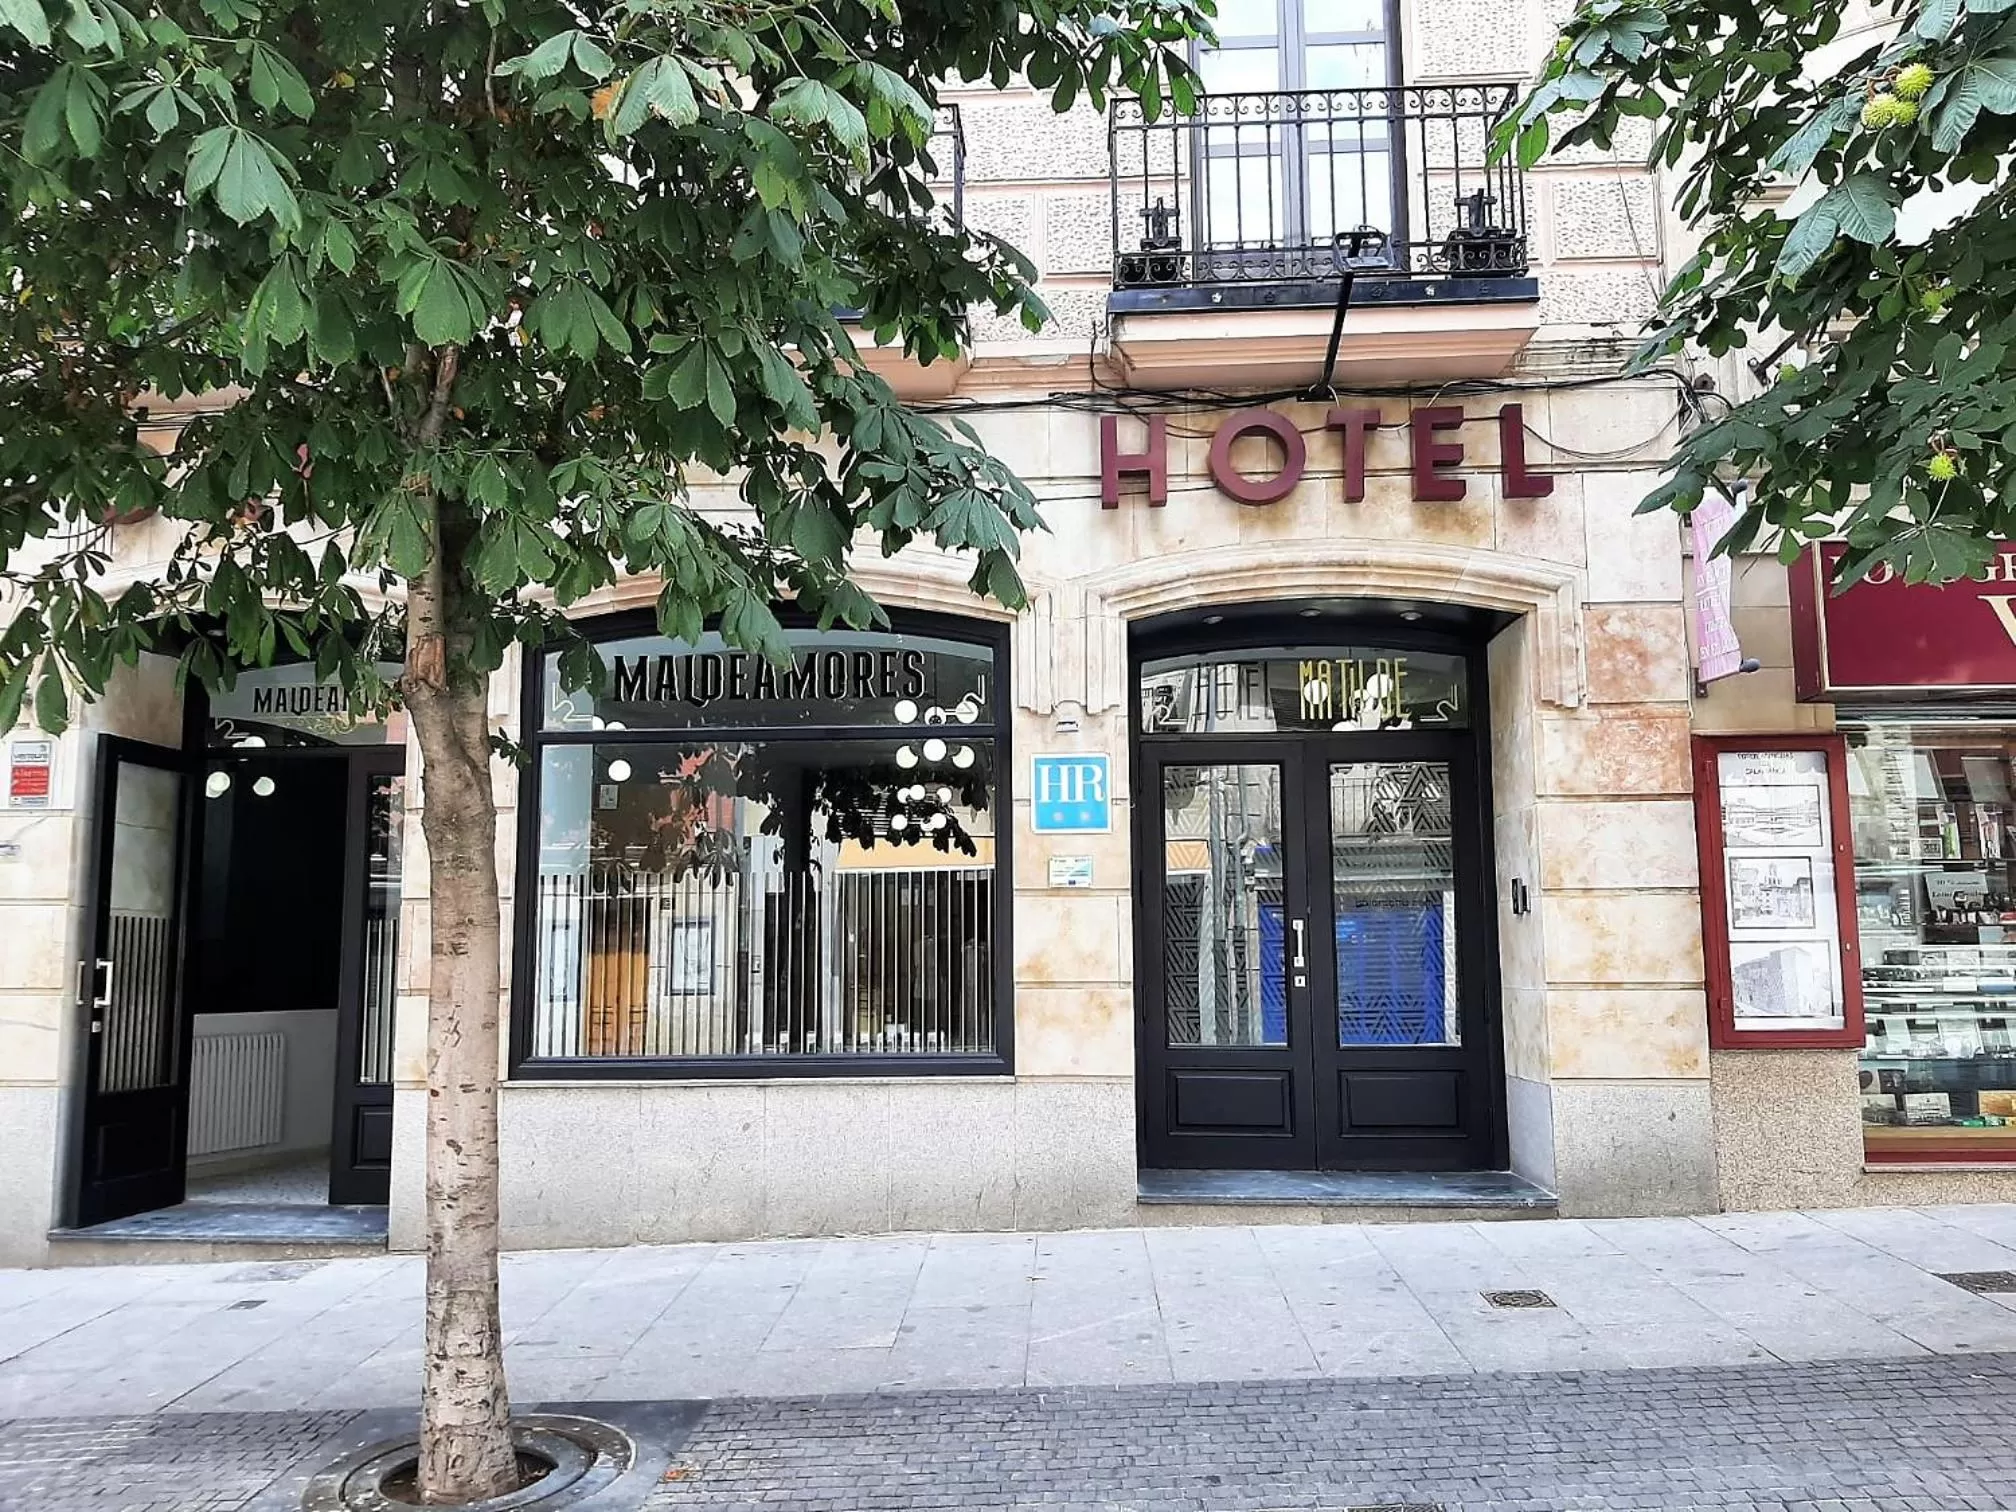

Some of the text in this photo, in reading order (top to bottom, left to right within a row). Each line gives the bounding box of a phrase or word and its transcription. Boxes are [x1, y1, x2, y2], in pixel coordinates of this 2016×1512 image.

[1100, 403, 1554, 509] HOTEL
[613, 649, 926, 708] MALDEAMORES
[1036, 764, 1106, 803] HR
